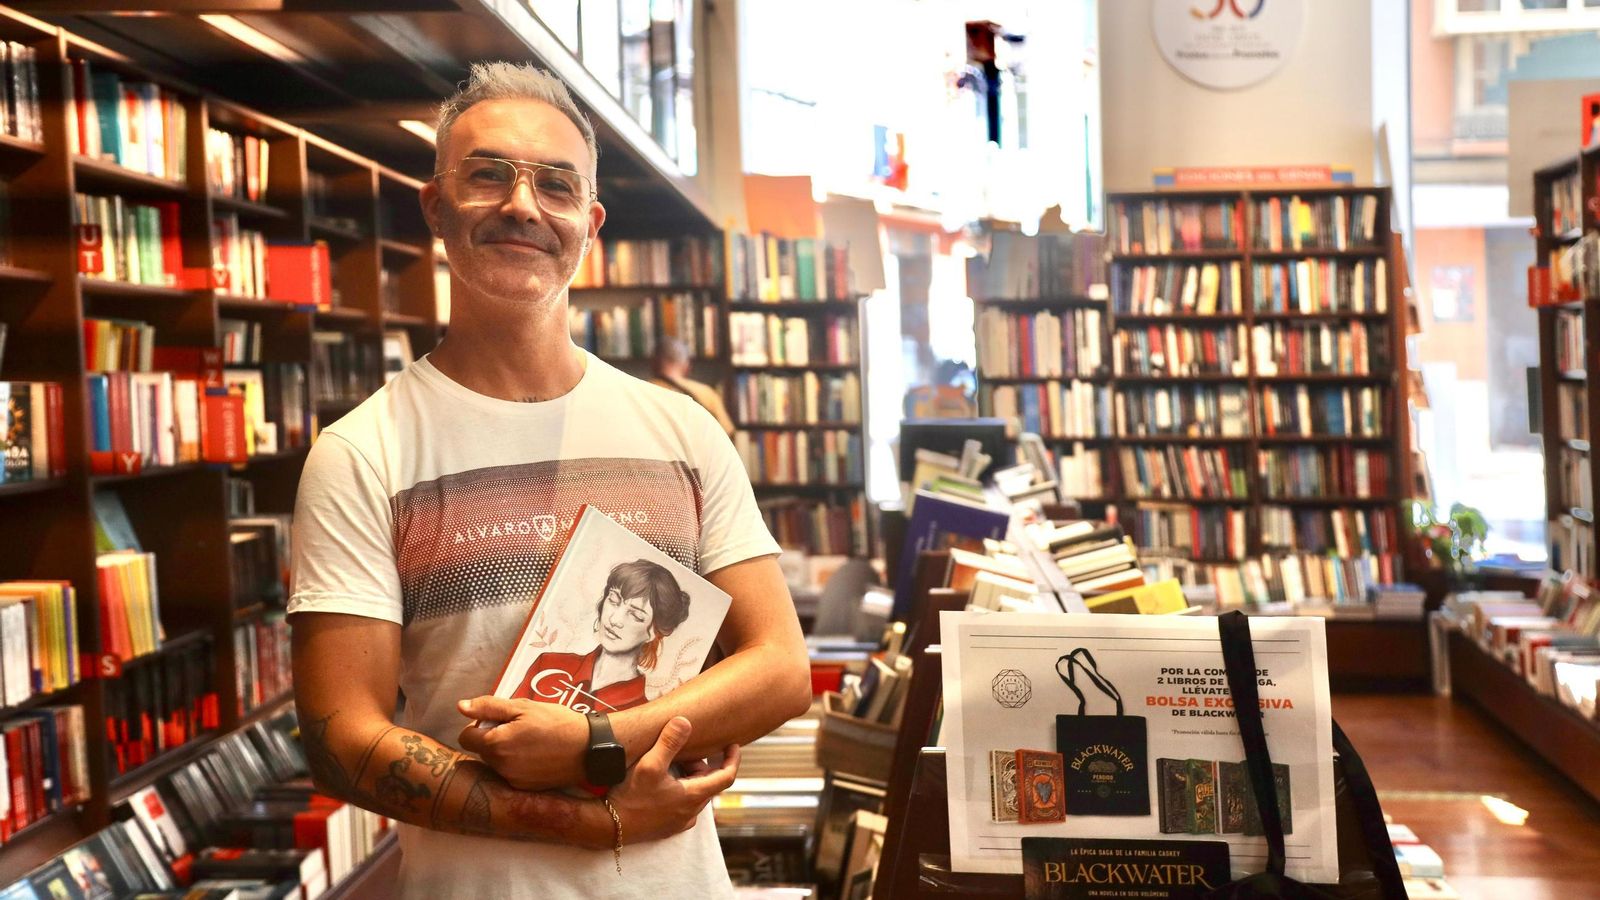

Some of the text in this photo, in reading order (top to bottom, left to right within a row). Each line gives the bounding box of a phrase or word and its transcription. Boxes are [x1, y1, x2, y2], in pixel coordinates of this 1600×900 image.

[82, 251, 97, 270] T
[121, 453, 138, 473] Y
[454, 520, 532, 545] ALVARO
[561, 510, 648, 531] MENO
[101, 655, 116, 676] S
[1160, 667, 1184, 676] POR
[1187, 668, 1201, 676] LA
[1157, 677, 1164, 685] 2
[1167, 677, 1207, 686] LIBROS
[1210, 678, 1224, 686] DE
[1182, 685, 1230, 695] LLÉVATE
[1146, 696, 1294, 710] BOLSA EXCSIVA
[1172, 709, 1264, 718] DE BLACKWR
[1071, 744, 1134, 772] BLACKWATER
[1070, 848, 1078, 856] LA
[1080, 847, 1097, 856] ÉPICA
[1098, 848, 1113, 856] SAGA
[1115, 849, 1122, 857] DE
[1124, 849, 1133, 857] LA
[1134, 849, 1157, 857] FAMILIA
[1044, 862, 1216, 890] BLACKWATER
[1099, 889, 1119, 897] NOVELA
